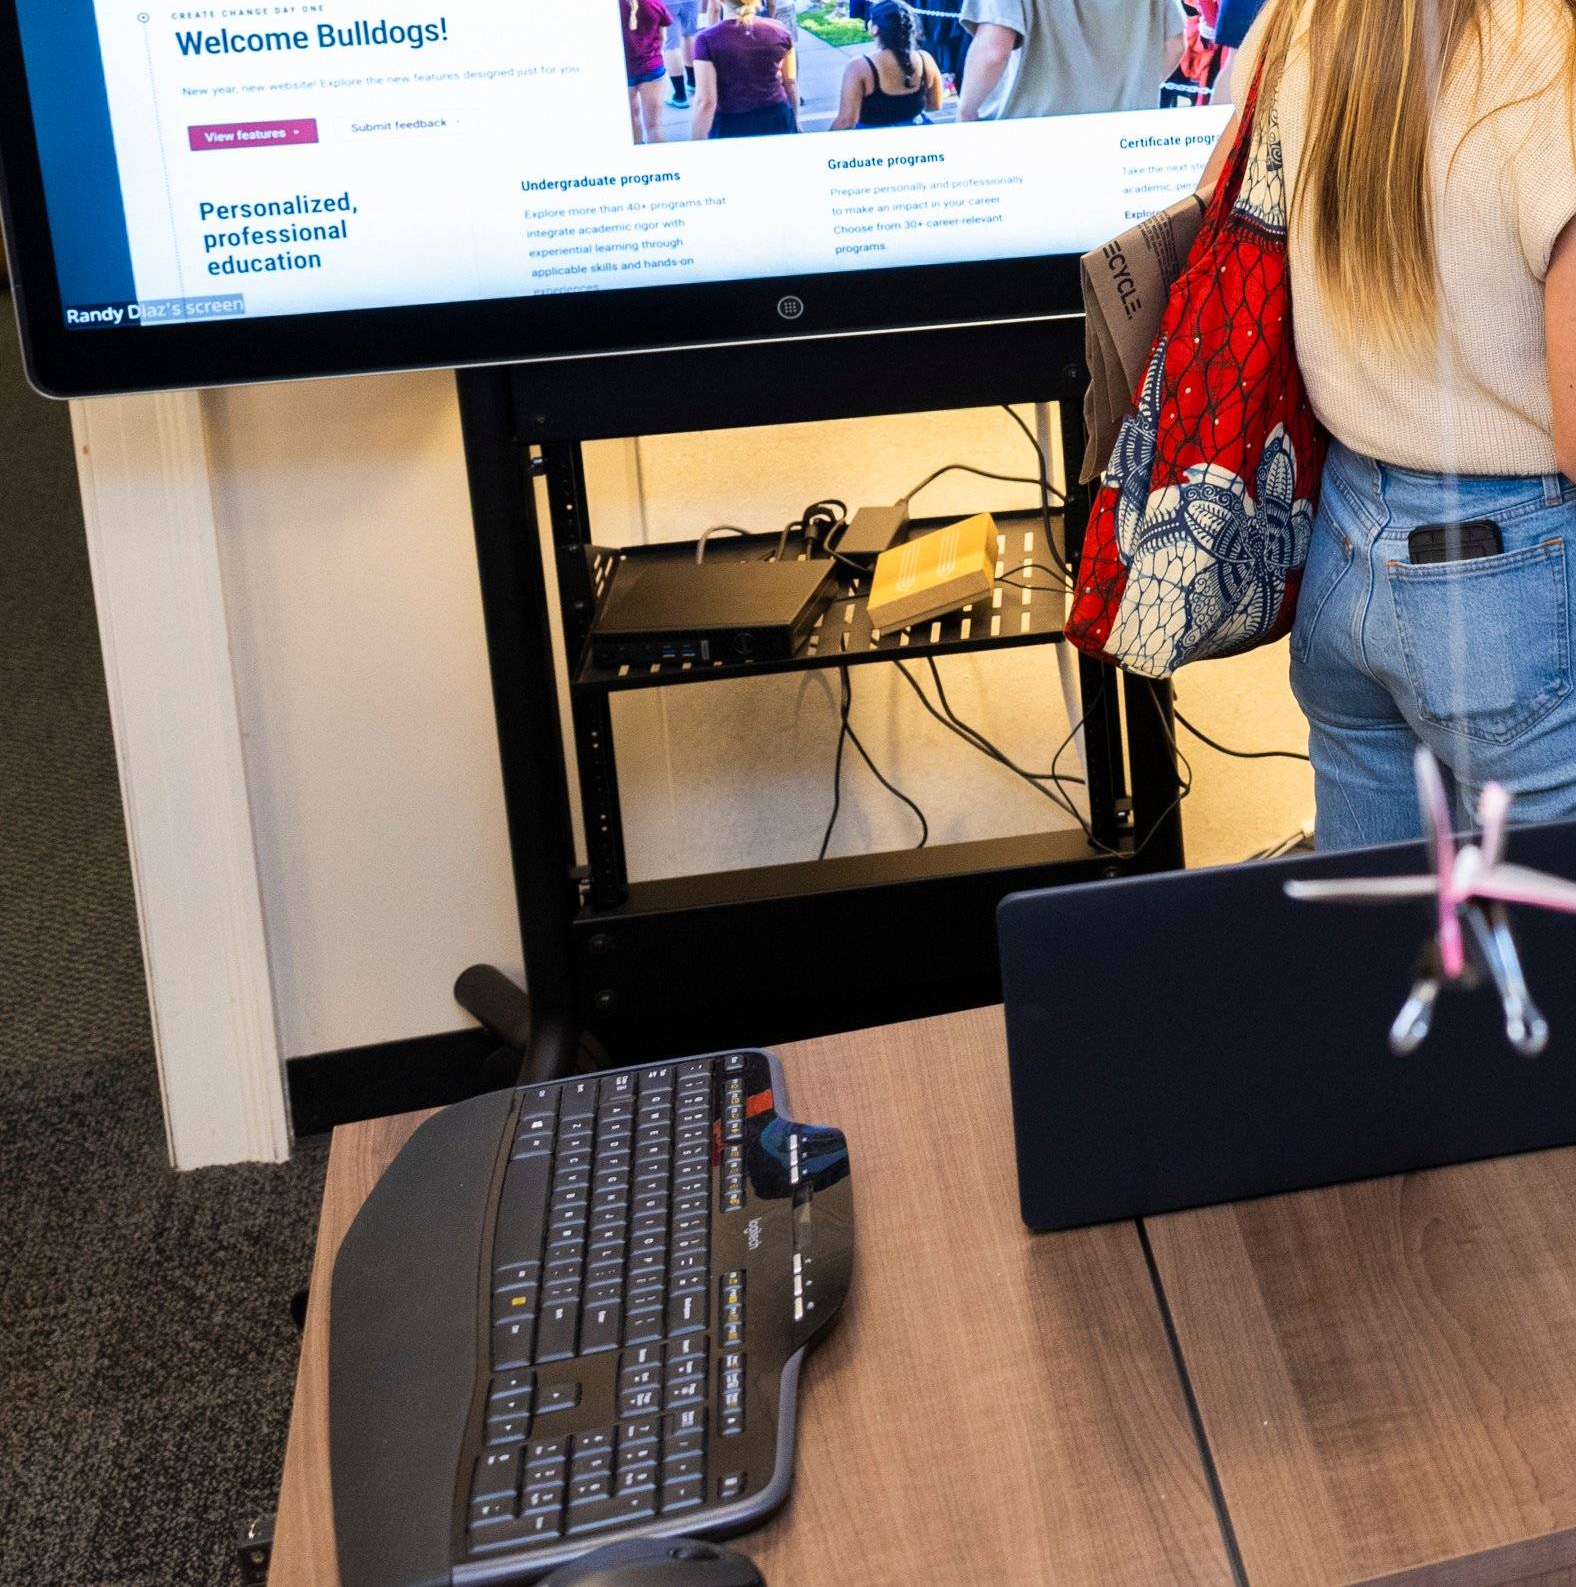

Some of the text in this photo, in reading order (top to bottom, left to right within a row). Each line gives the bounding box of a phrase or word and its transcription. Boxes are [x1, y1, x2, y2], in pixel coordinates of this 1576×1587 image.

[171, 5, 325, 20] CREATE CHANGE DAY ONE
[175, 17, 448, 56] Welcome Bulldogs!
[182, 67, 514, 97] New Explore the new features designed
[204, 128, 286, 143] View features
[351, 118, 447, 133] Submit feedback
[1120, 136, 1181, 149] Certificate
[828, 152, 945, 170] Graduate programs
[521, 171, 681, 192] Undergraduate programs
[830, 175, 1024, 197] Prepare personally and professionally
[200, 192, 358, 221] Personalized,
[525, 196, 726, 220] Explore more than 40+ programs that
[845, 198, 966, 214] make an impact in your
[204, 219, 347, 253] professional
[527, 218, 685, 239] integrate academic rigor with
[834, 220, 923, 235] Choose from 30+
[529, 237, 684, 258] experiential learning through
[208, 251, 322, 275] education
[531, 256, 694, 278] applicable skills and hands-on
[66, 298, 244, 325] Randy Diaz's screen
